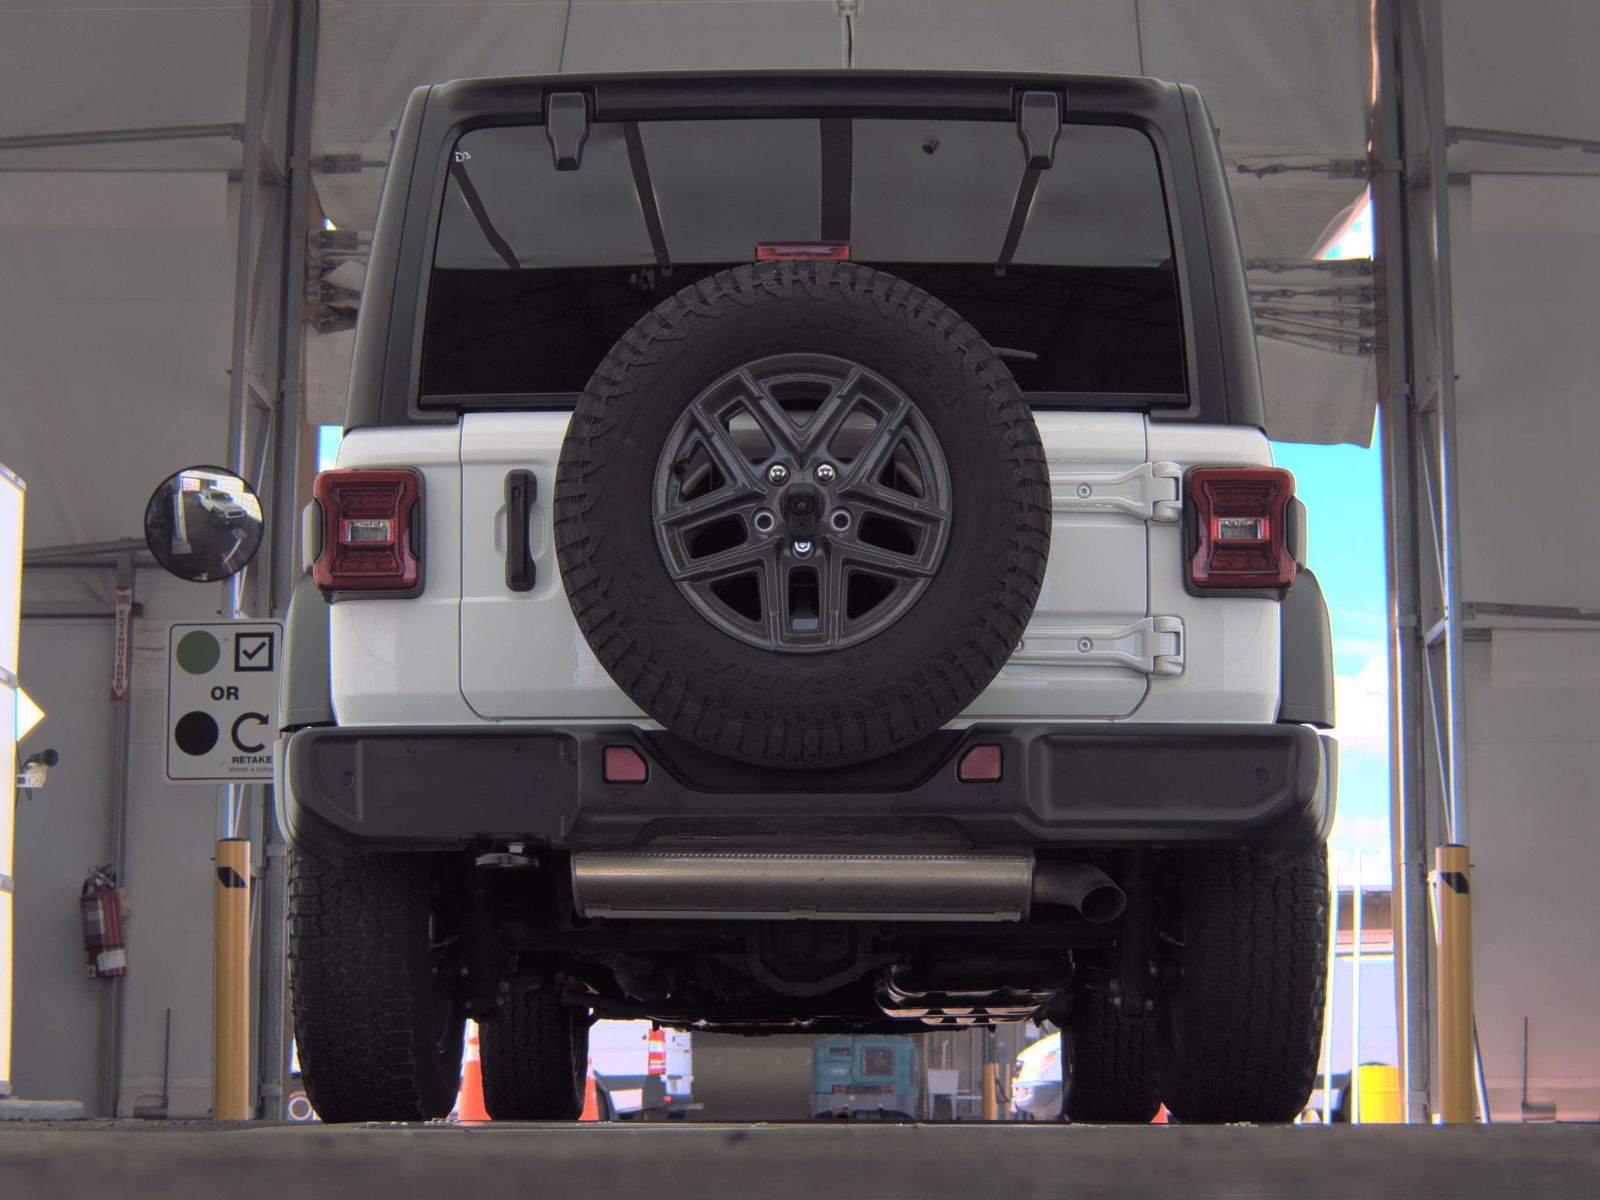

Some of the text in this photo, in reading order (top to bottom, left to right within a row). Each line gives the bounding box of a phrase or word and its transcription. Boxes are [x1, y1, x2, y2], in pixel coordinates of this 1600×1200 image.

[115, 608, 126, 691] EXTINGUISHER
[210, 685, 239, 701] OR
[231, 755, 273, 764] RETAKE
